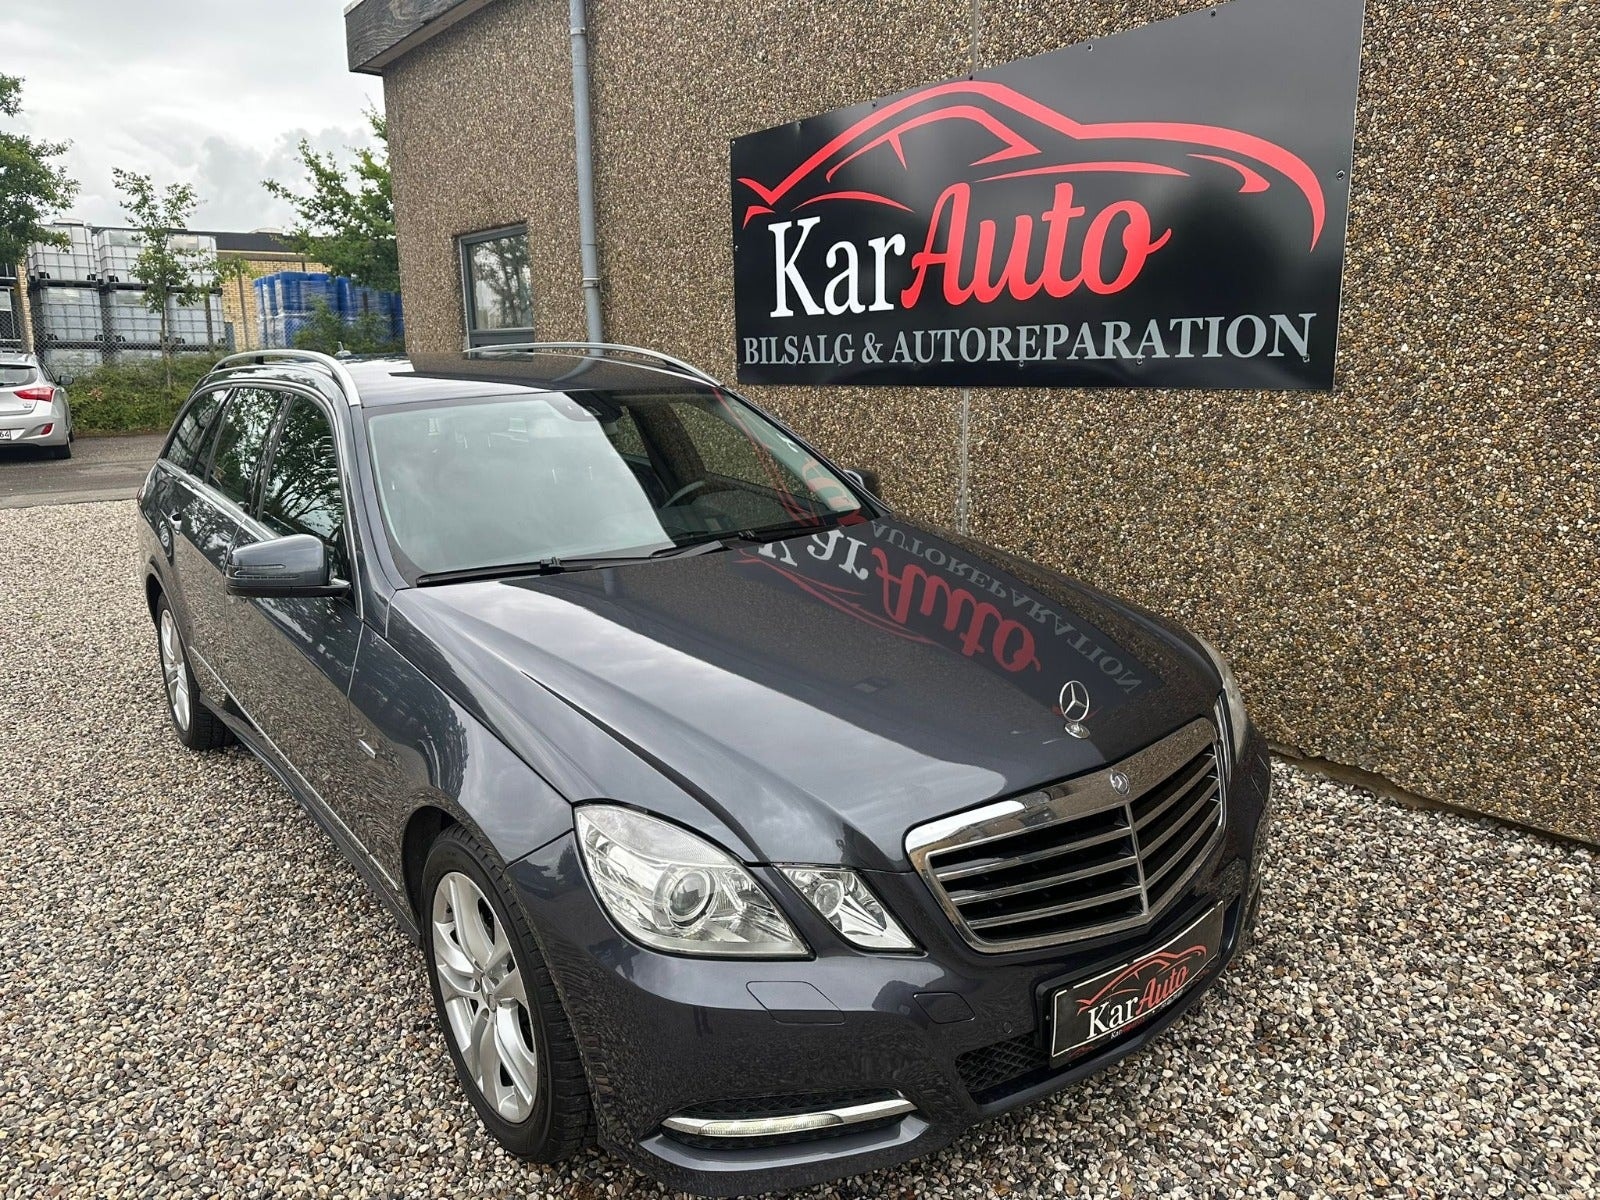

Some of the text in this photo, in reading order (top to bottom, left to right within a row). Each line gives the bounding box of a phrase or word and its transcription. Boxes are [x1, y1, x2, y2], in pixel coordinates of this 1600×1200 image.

[768, 183, 1172, 317] KarAuto
[743, 313, 1317, 366] BILSALG & AUTOREPARATION
[1086, 966, 1190, 1040] KarAuto
